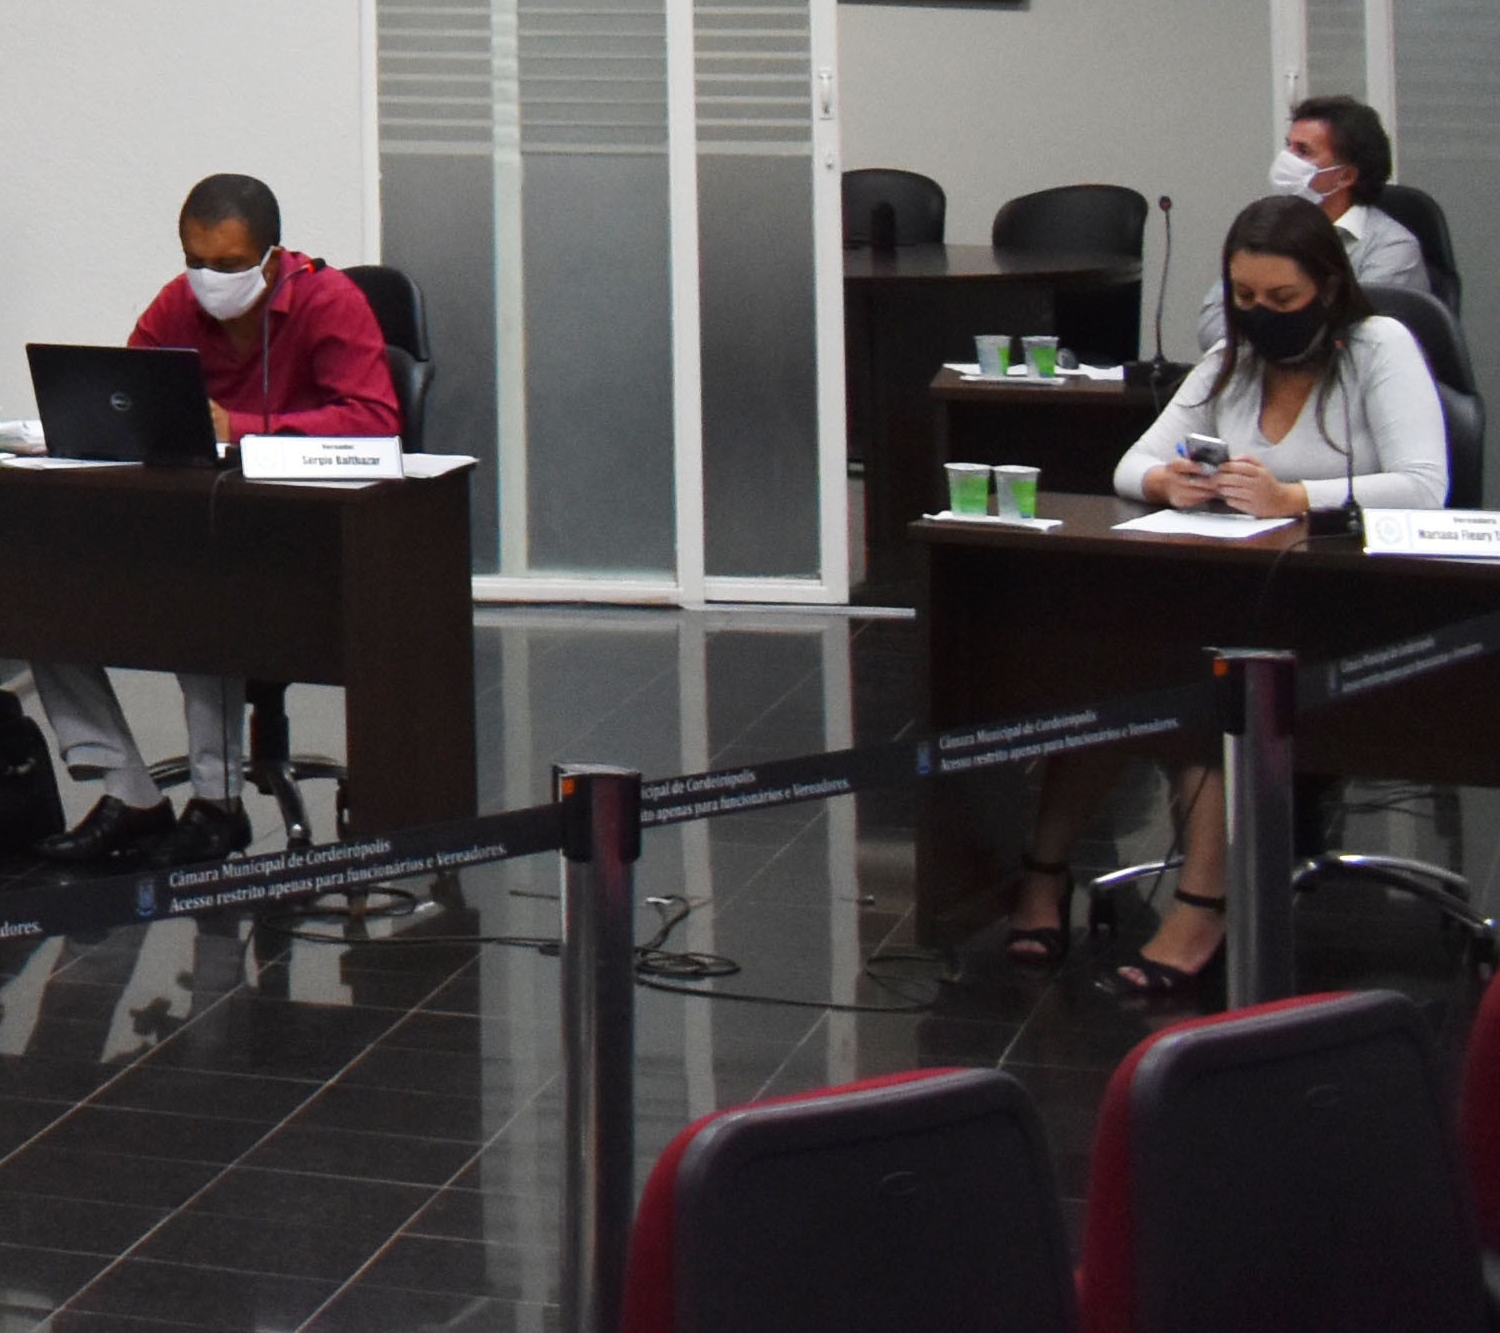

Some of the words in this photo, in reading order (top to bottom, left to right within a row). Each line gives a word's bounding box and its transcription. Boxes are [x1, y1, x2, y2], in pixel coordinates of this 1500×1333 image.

[169, 866, 219, 889] Câmara
[222, 853, 286, 883] Municipal
[288, 852, 304, 869] de
[305, 838, 391, 866] Cordeirópolis
[169, 893, 215, 914] Acesso
[217, 884, 266, 907] restrito
[268, 878, 314, 902] apenas
[316, 871, 345, 894] para
[346, 856, 425, 885] funcionários
